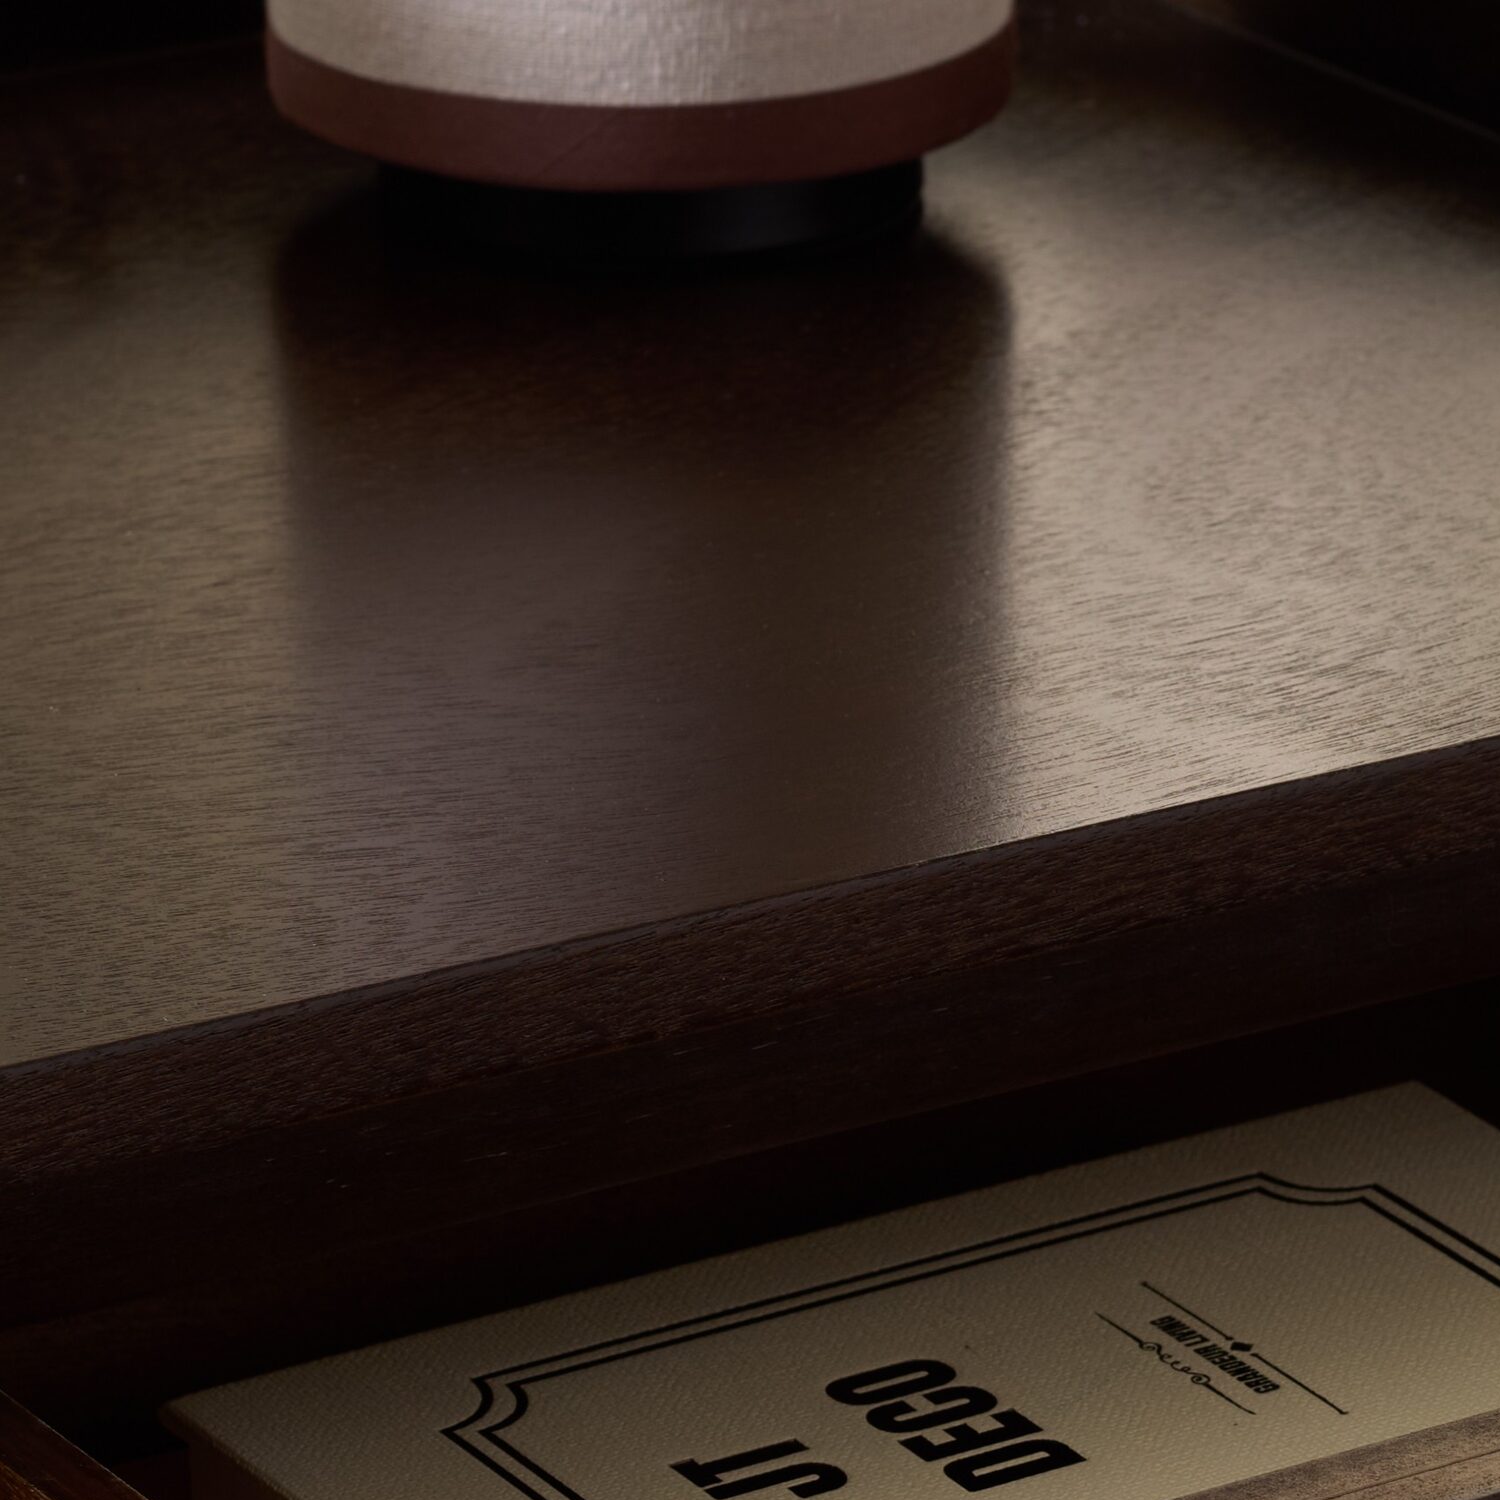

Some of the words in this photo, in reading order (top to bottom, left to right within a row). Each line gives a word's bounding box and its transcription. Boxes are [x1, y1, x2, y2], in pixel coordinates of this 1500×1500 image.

[1149, 1314, 1211, 1348] LIVING
[1193, 1343, 1281, 1394] GRANDEUR
[825, 1358, 1088, 1493] DECO
[669, 1438, 848, 1500] JT
